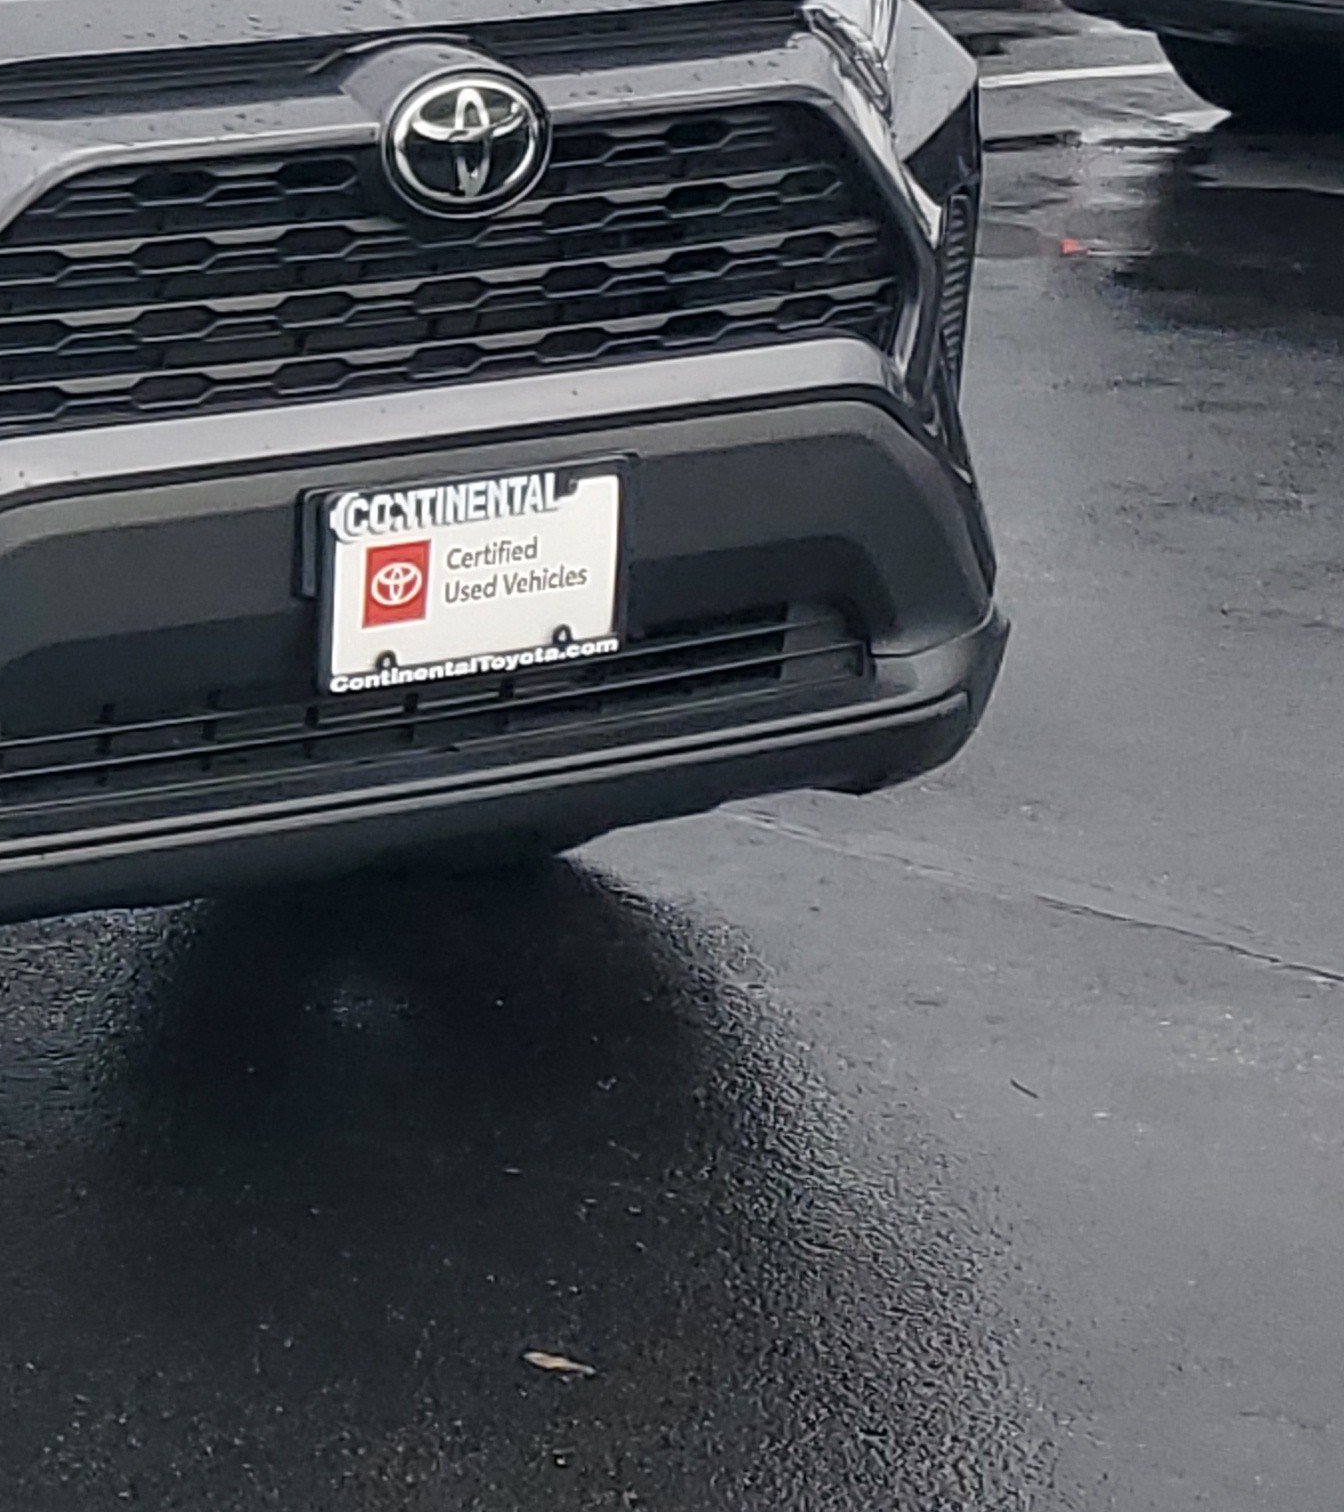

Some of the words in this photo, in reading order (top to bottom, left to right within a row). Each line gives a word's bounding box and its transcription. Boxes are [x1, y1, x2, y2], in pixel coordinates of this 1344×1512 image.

[332, 472, 559, 538] CONTINENTAL
[446, 536, 538, 570] Certified
[444, 573, 498, 604] Used
[502, 565, 588, 595] Vehicles
[329, 635, 619, 694] ContinentalToyota.com
